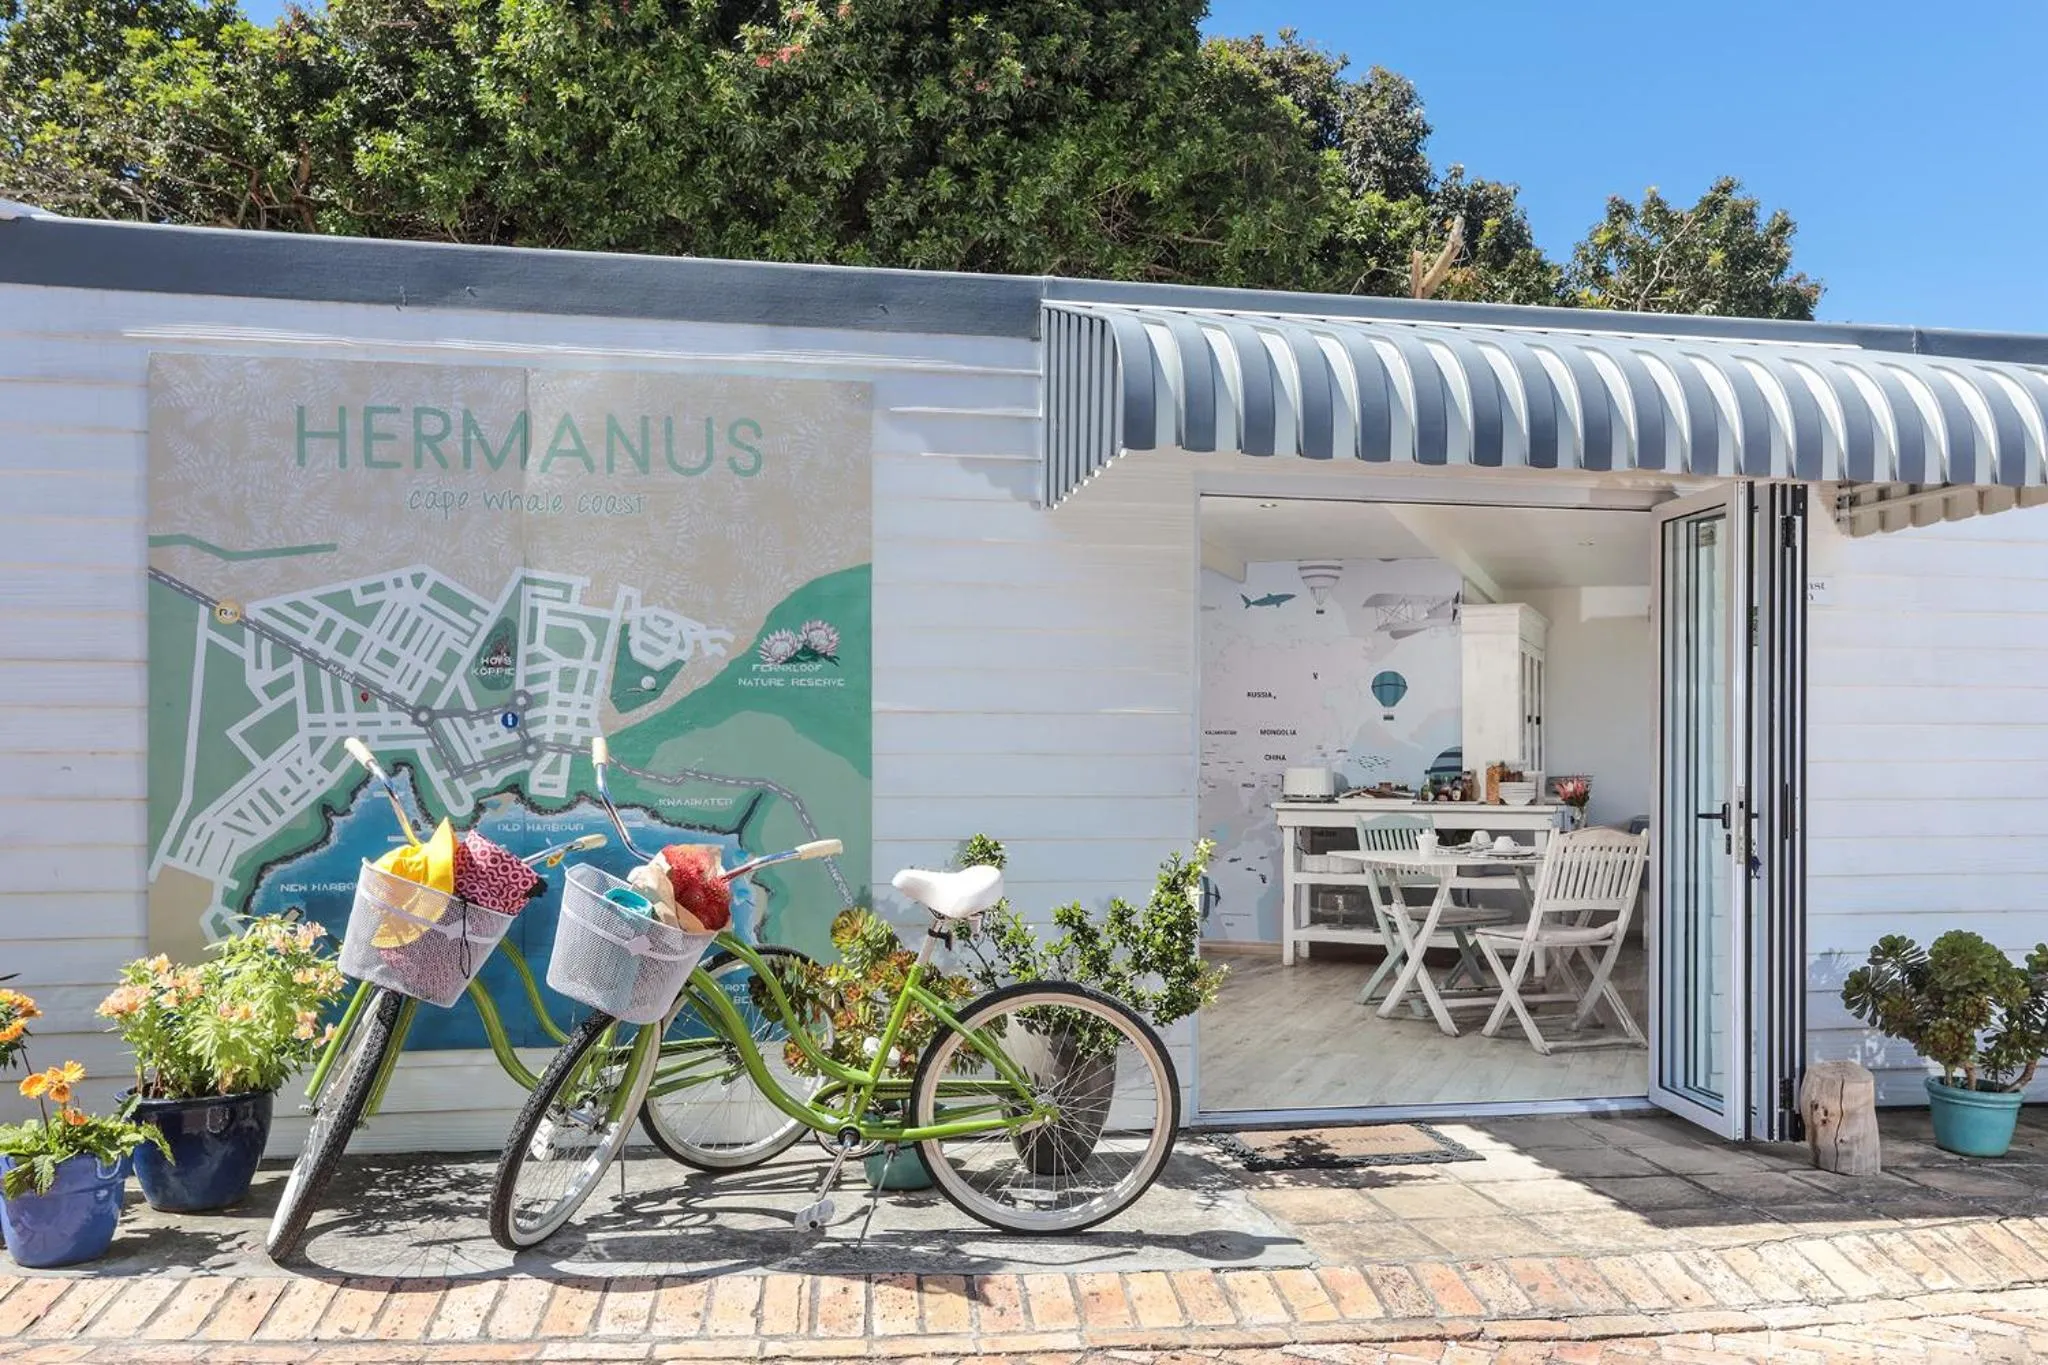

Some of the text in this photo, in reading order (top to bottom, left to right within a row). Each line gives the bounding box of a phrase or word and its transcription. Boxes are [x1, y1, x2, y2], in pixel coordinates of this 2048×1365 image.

[296, 405, 764, 477] HERMANUS
[408, 487, 646, 520] cape whale coast
[327, 663, 356, 683] MAIN
[471, 667, 515, 676] KOPPIE
[738, 678, 845, 687] NATURE RESERVE
[497, 823, 584, 832] OLD HARBOUR
[280, 882, 358, 892] NEW HARBO
